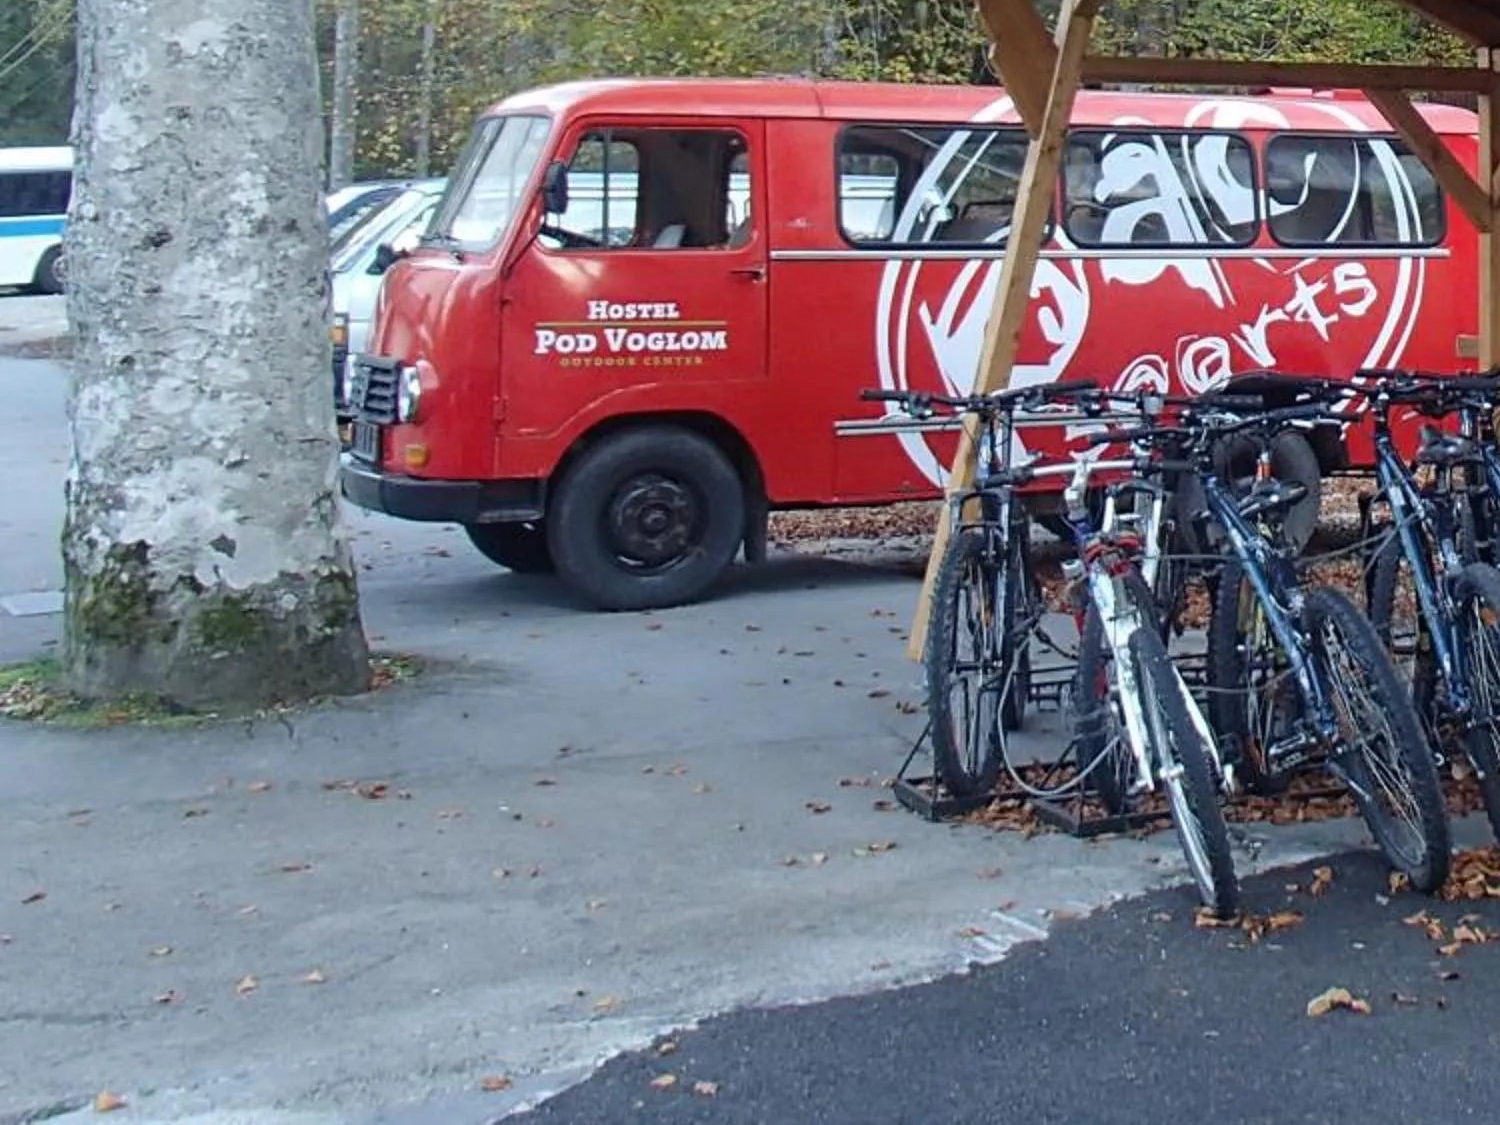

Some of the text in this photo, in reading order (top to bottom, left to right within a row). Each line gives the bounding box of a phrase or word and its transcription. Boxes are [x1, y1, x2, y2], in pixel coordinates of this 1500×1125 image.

[586, 300, 680, 320] HOSTEL
[534, 327, 728, 354] POD VOGLOM
